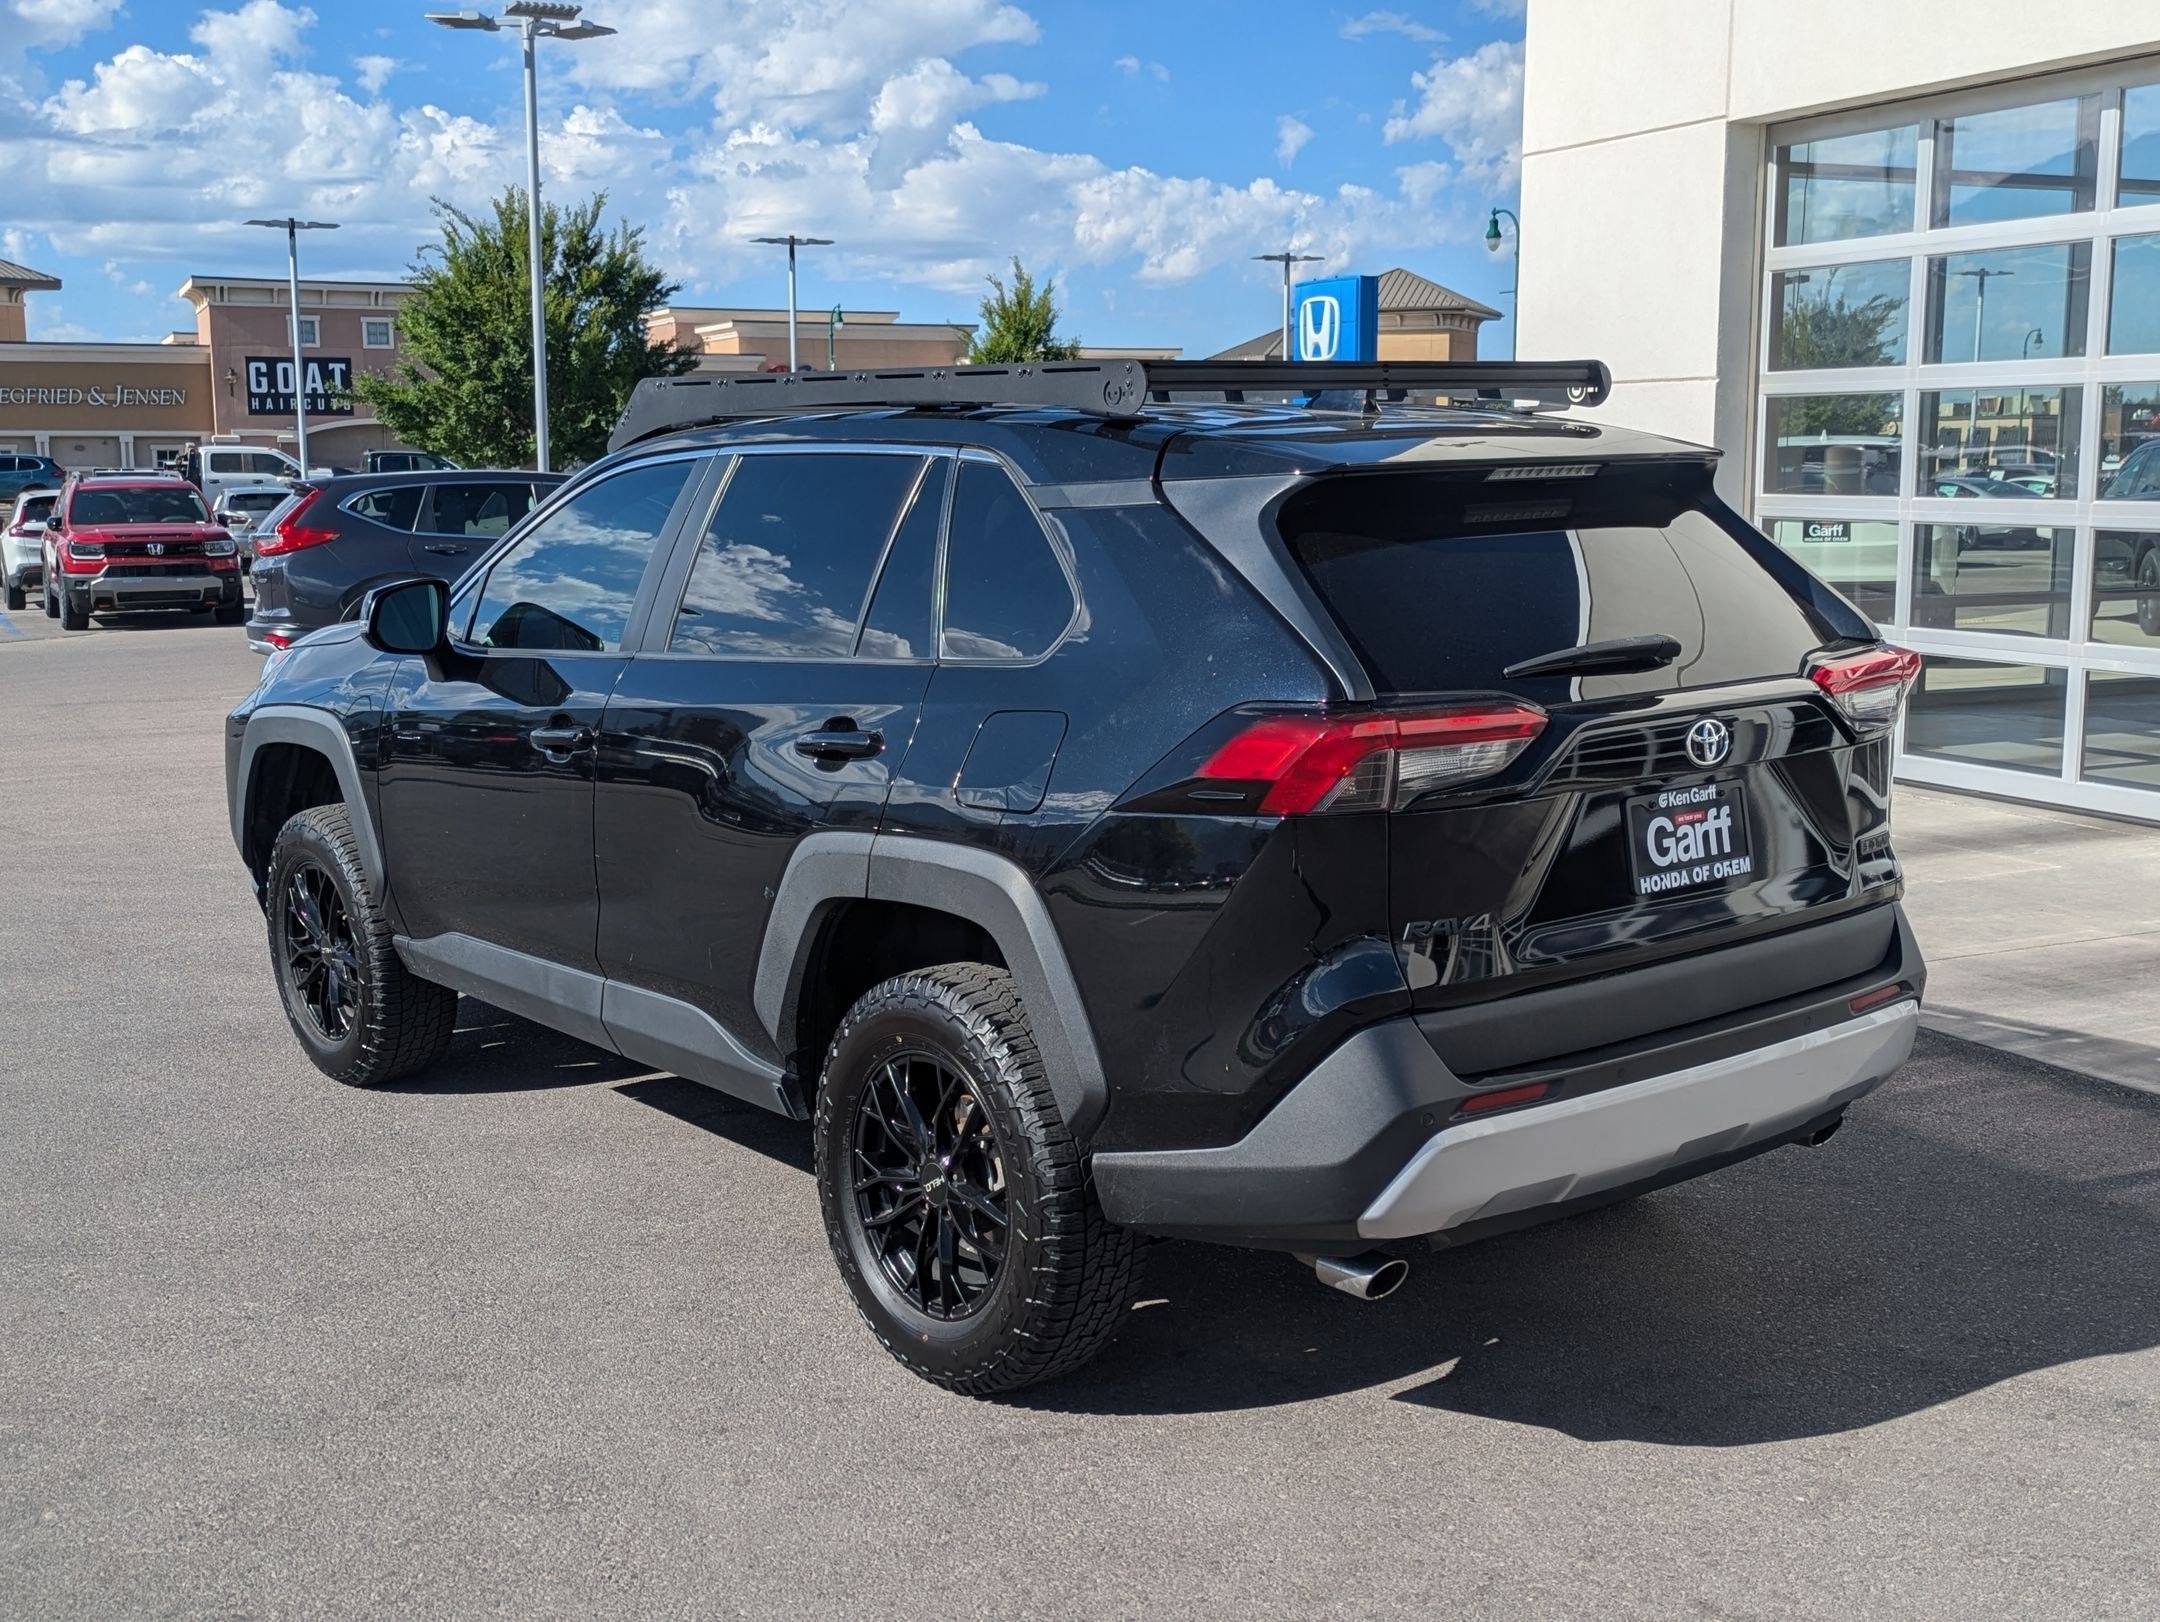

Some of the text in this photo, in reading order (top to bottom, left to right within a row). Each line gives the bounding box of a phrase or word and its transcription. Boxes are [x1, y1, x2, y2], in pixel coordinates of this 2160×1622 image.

[87, 386, 108, 406] &
[112, 385, 186, 408] JENSEN
[1808, 524, 1844, 537] Garff
[1646, 805, 1732, 867] Garff
[1640, 856, 1752, 894] HONDA OF OREM
[1402, 912, 1491, 941] RAV4
